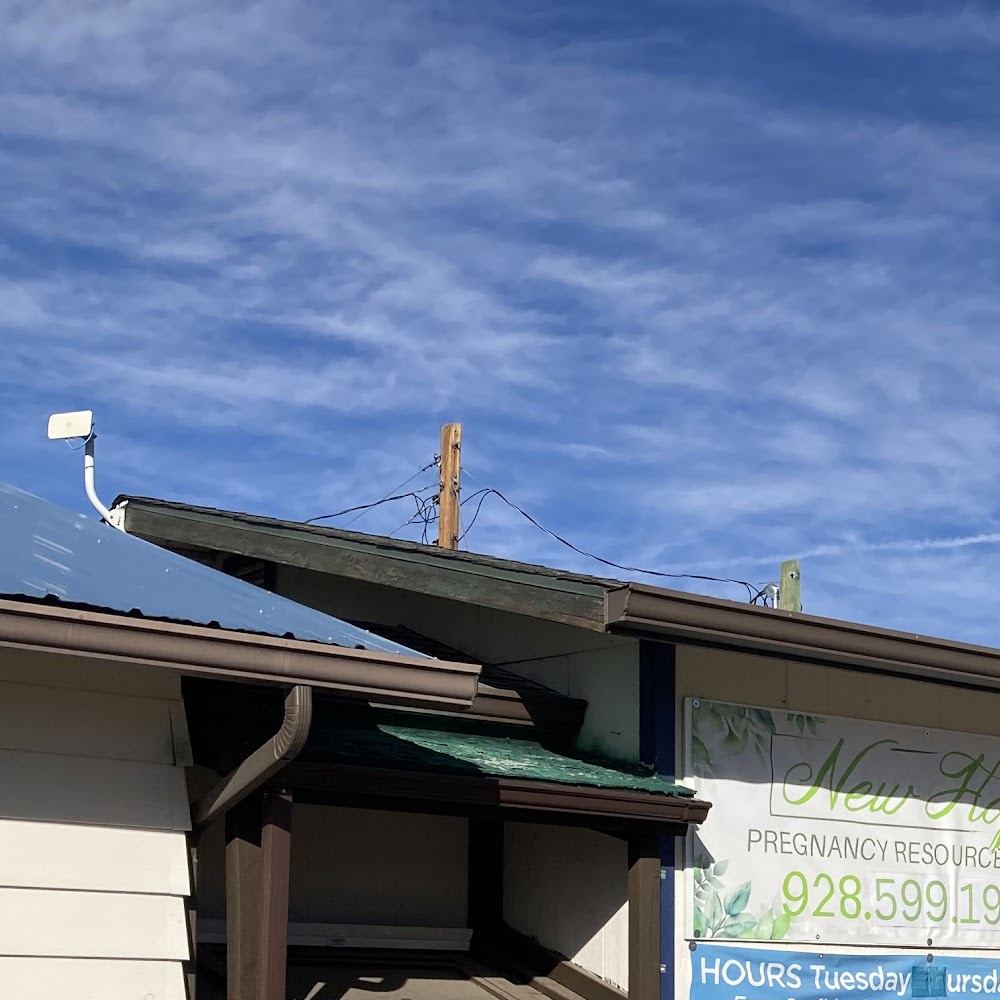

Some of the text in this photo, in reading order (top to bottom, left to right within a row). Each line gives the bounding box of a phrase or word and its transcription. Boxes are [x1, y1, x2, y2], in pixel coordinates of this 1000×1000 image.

[782, 738, 920, 816] New
[747, 829, 888, 862] PREGNANCY
[700, 957, 802, 989] HOURS
[810, 965, 911, 996] Tuesday
